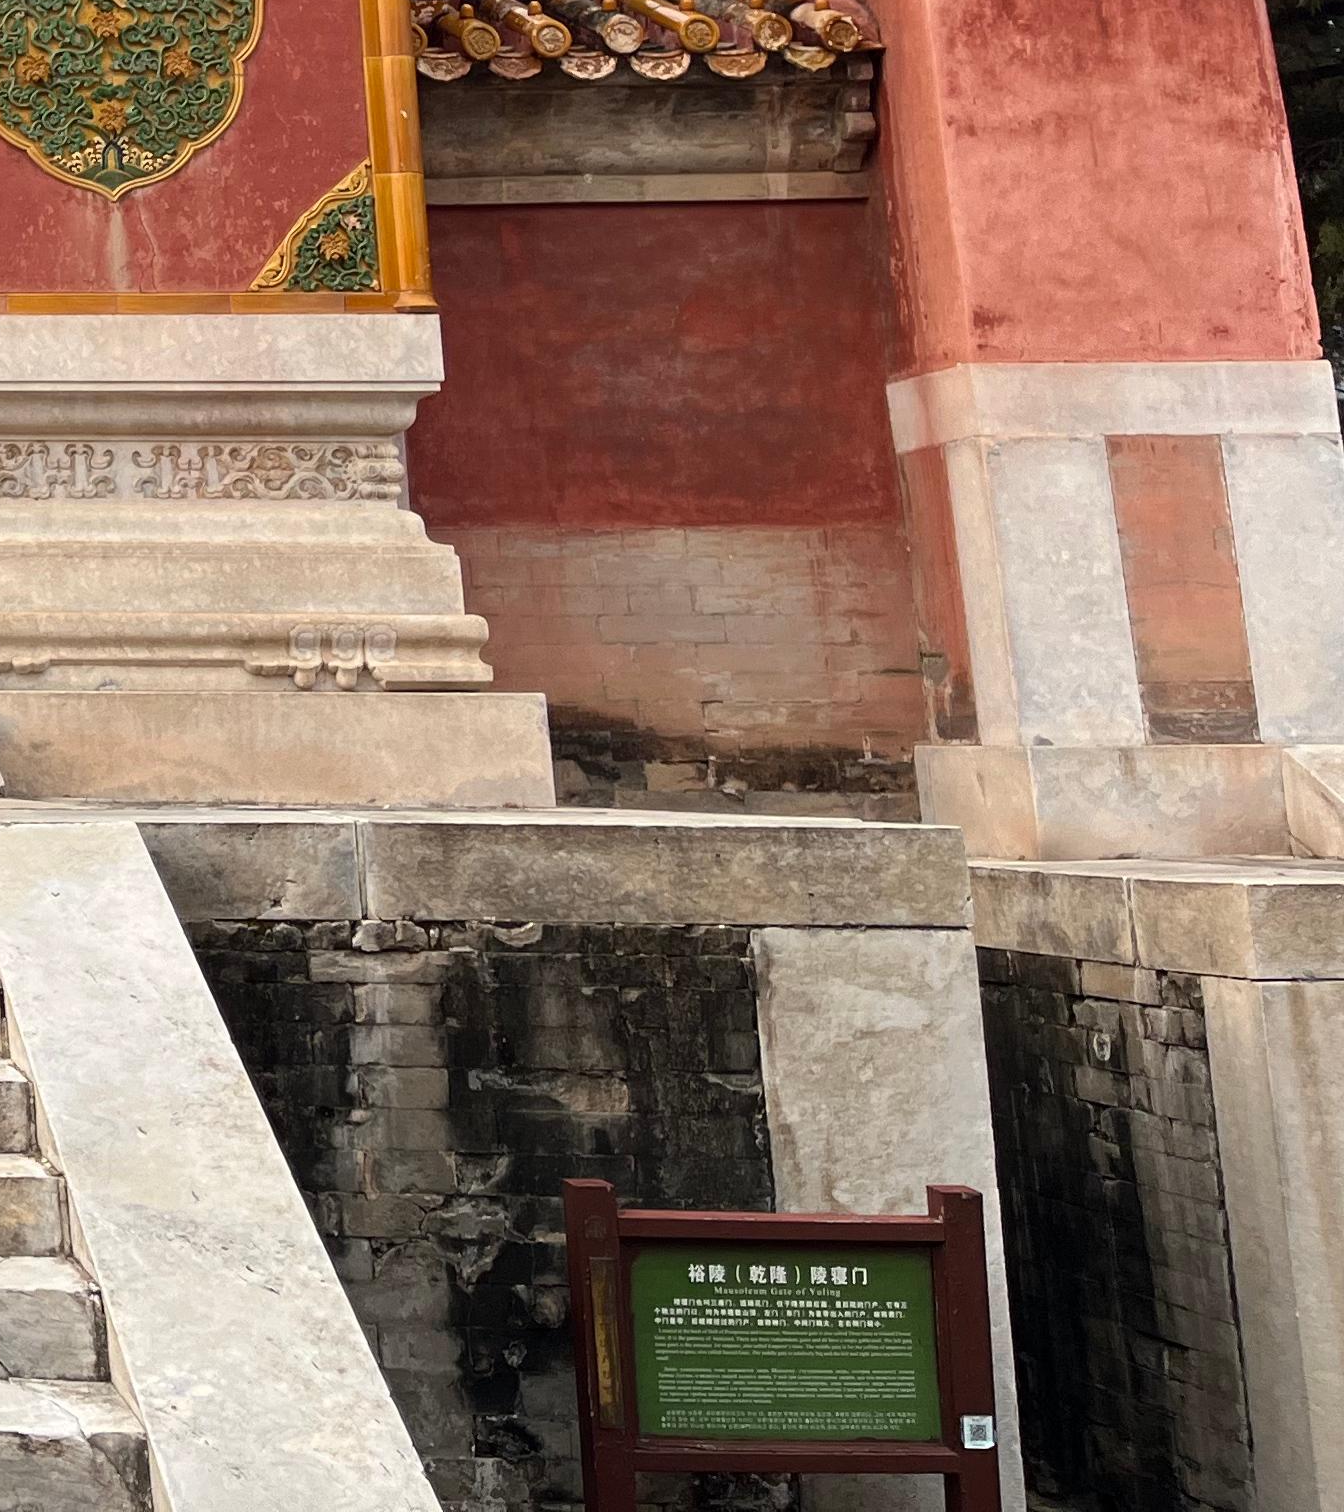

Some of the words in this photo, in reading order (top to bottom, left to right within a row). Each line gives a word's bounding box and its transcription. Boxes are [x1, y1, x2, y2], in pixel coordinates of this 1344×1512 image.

[714, 1286, 767, 1295] Mausoleum
[770, 1287, 793, 1296] Gate
[795, 1287, 807, 1296] of
